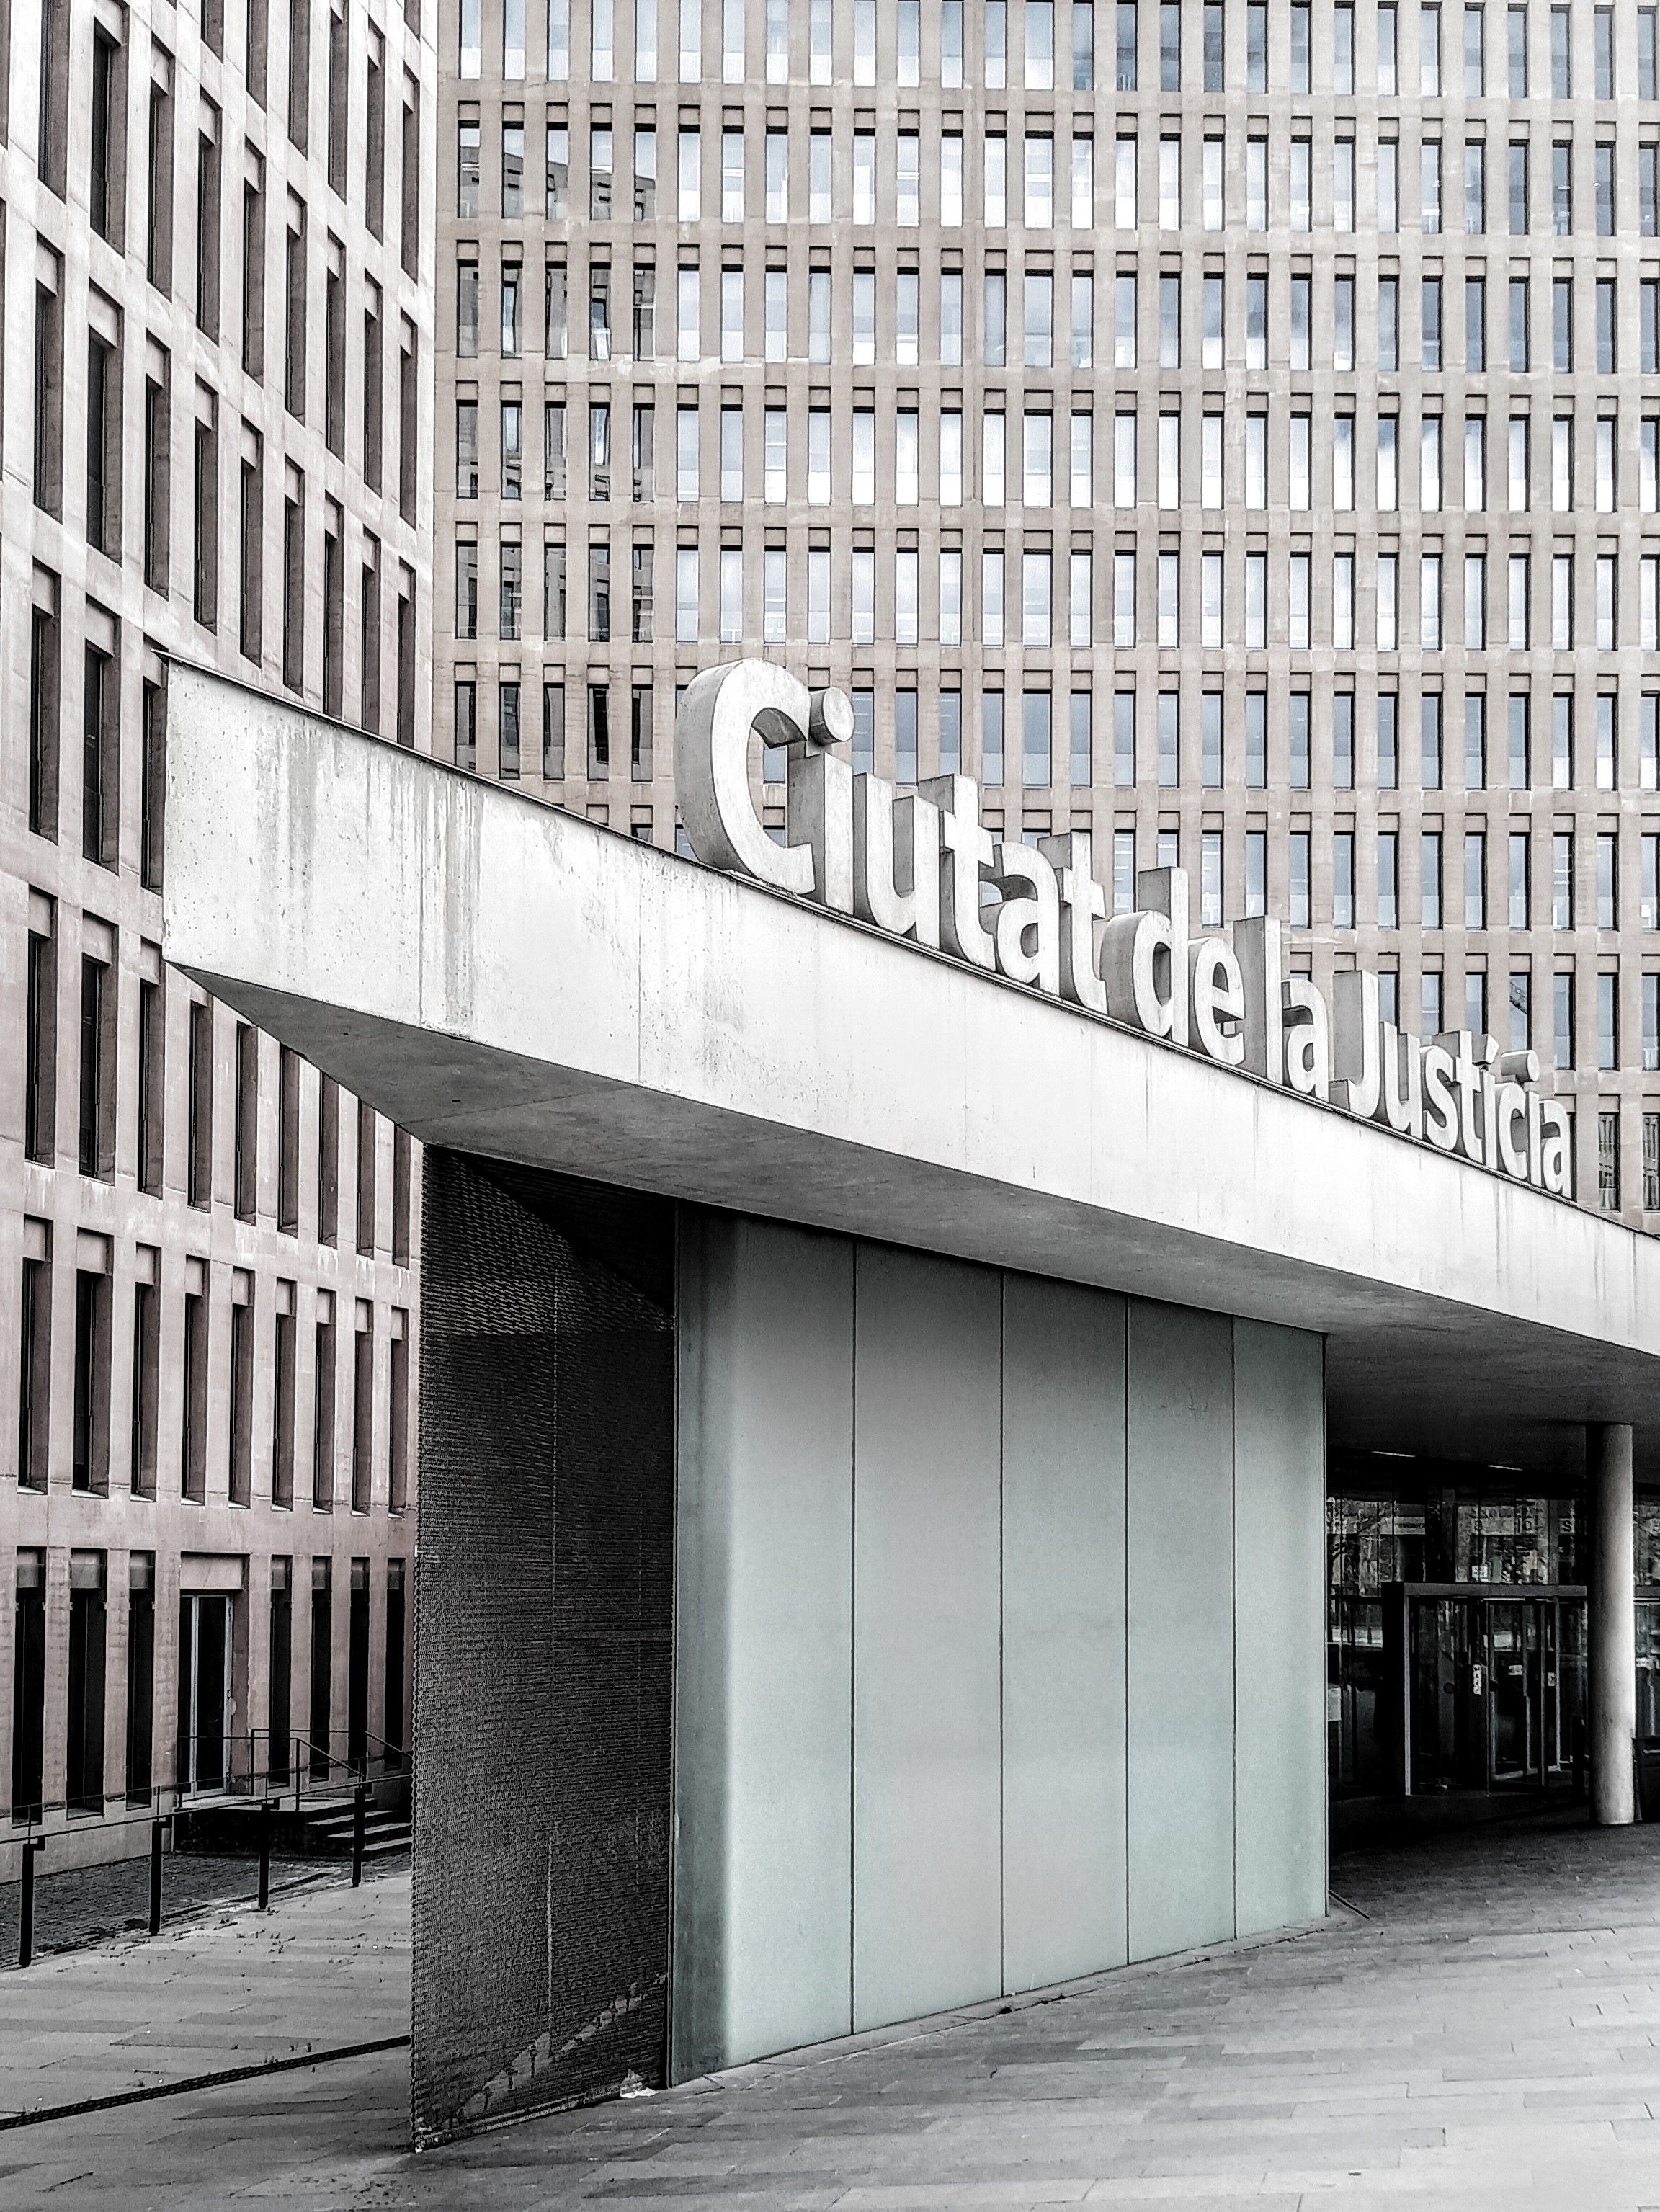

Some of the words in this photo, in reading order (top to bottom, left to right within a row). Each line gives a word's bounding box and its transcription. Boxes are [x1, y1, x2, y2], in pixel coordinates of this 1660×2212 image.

[674, 658, 1108, 1015] Ciutat
[1101, 867, 1245, 1066] de
[1233, 915, 1329, 1101] la
[1330, 970, 1573, 1199] Justicia
